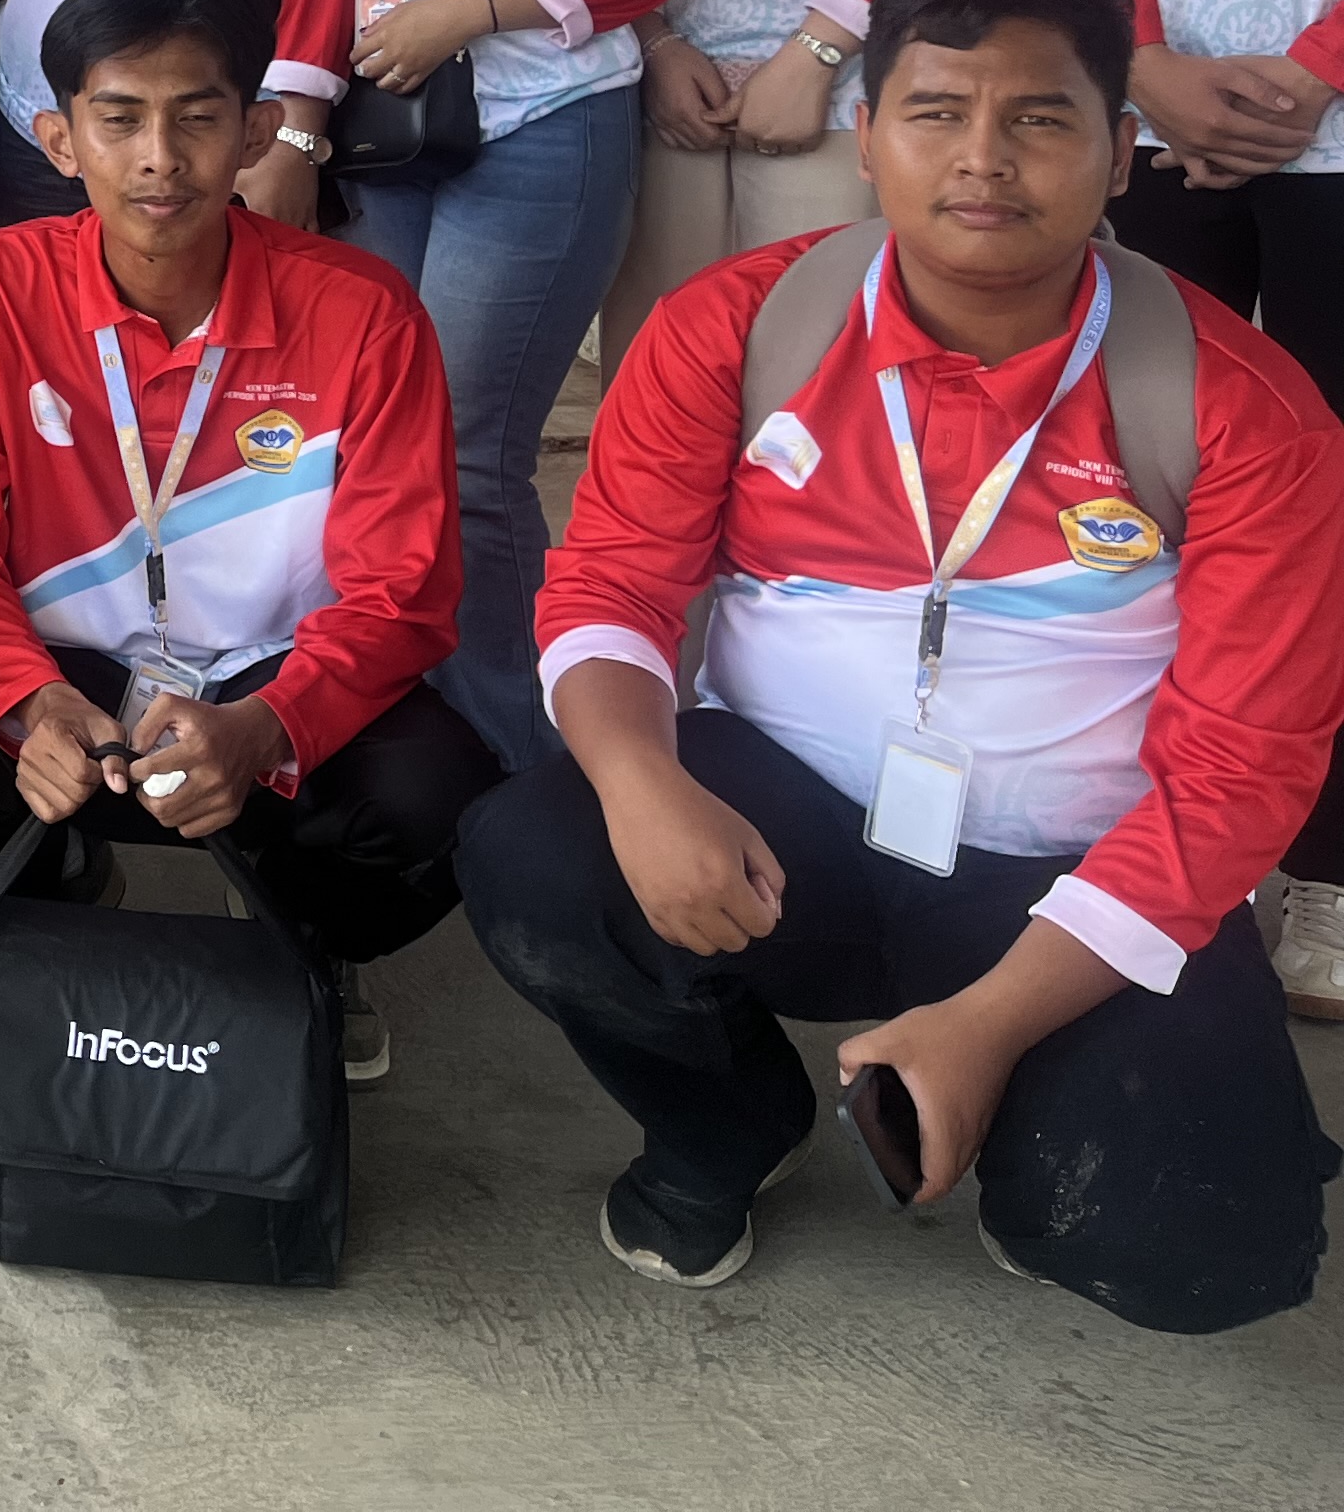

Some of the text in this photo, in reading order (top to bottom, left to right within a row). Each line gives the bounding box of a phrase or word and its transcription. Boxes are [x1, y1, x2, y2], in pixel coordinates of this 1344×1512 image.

[1046, 462, 1092, 481] PERIODE
[1095, 474, 1113, 486] VIII
[1078, 459, 1101, 473] KKN
